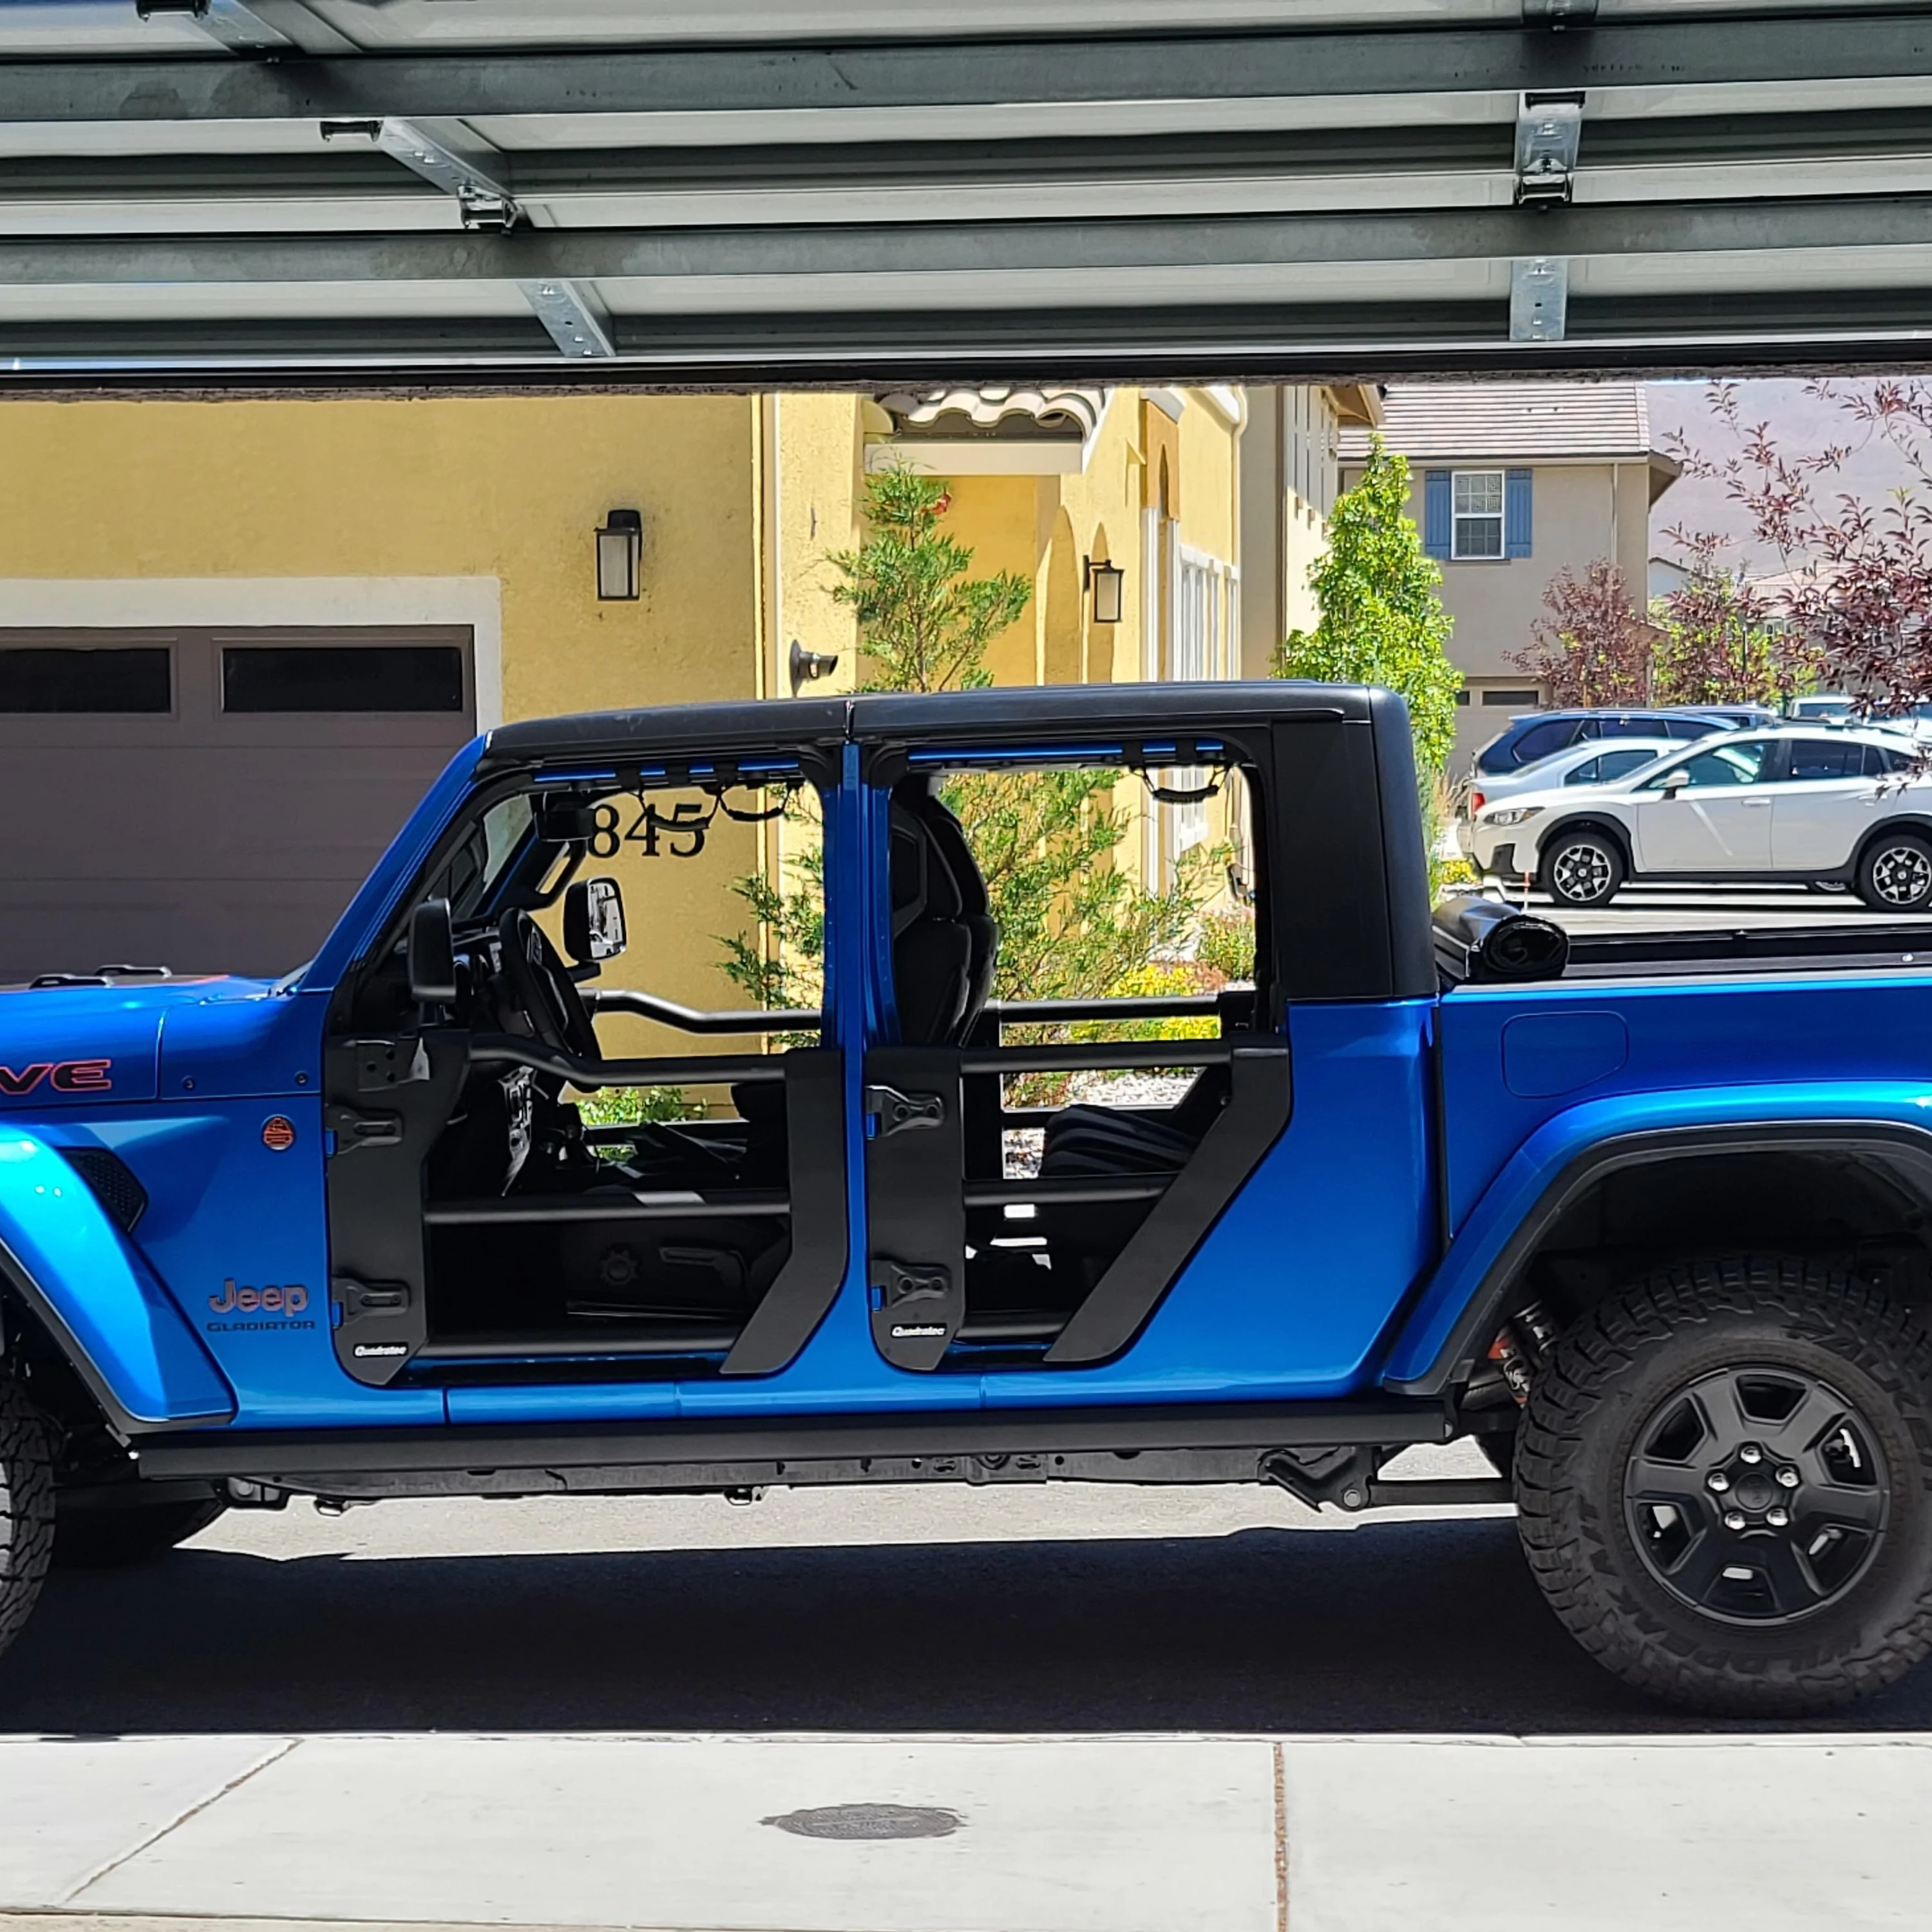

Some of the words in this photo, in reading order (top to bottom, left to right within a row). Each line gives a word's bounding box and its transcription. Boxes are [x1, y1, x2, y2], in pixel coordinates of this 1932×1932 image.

[587, 803, 705, 858] 845
[209, 1278, 308, 1318] Jeep
[206, 1320, 316, 1332] GLADIATOR
